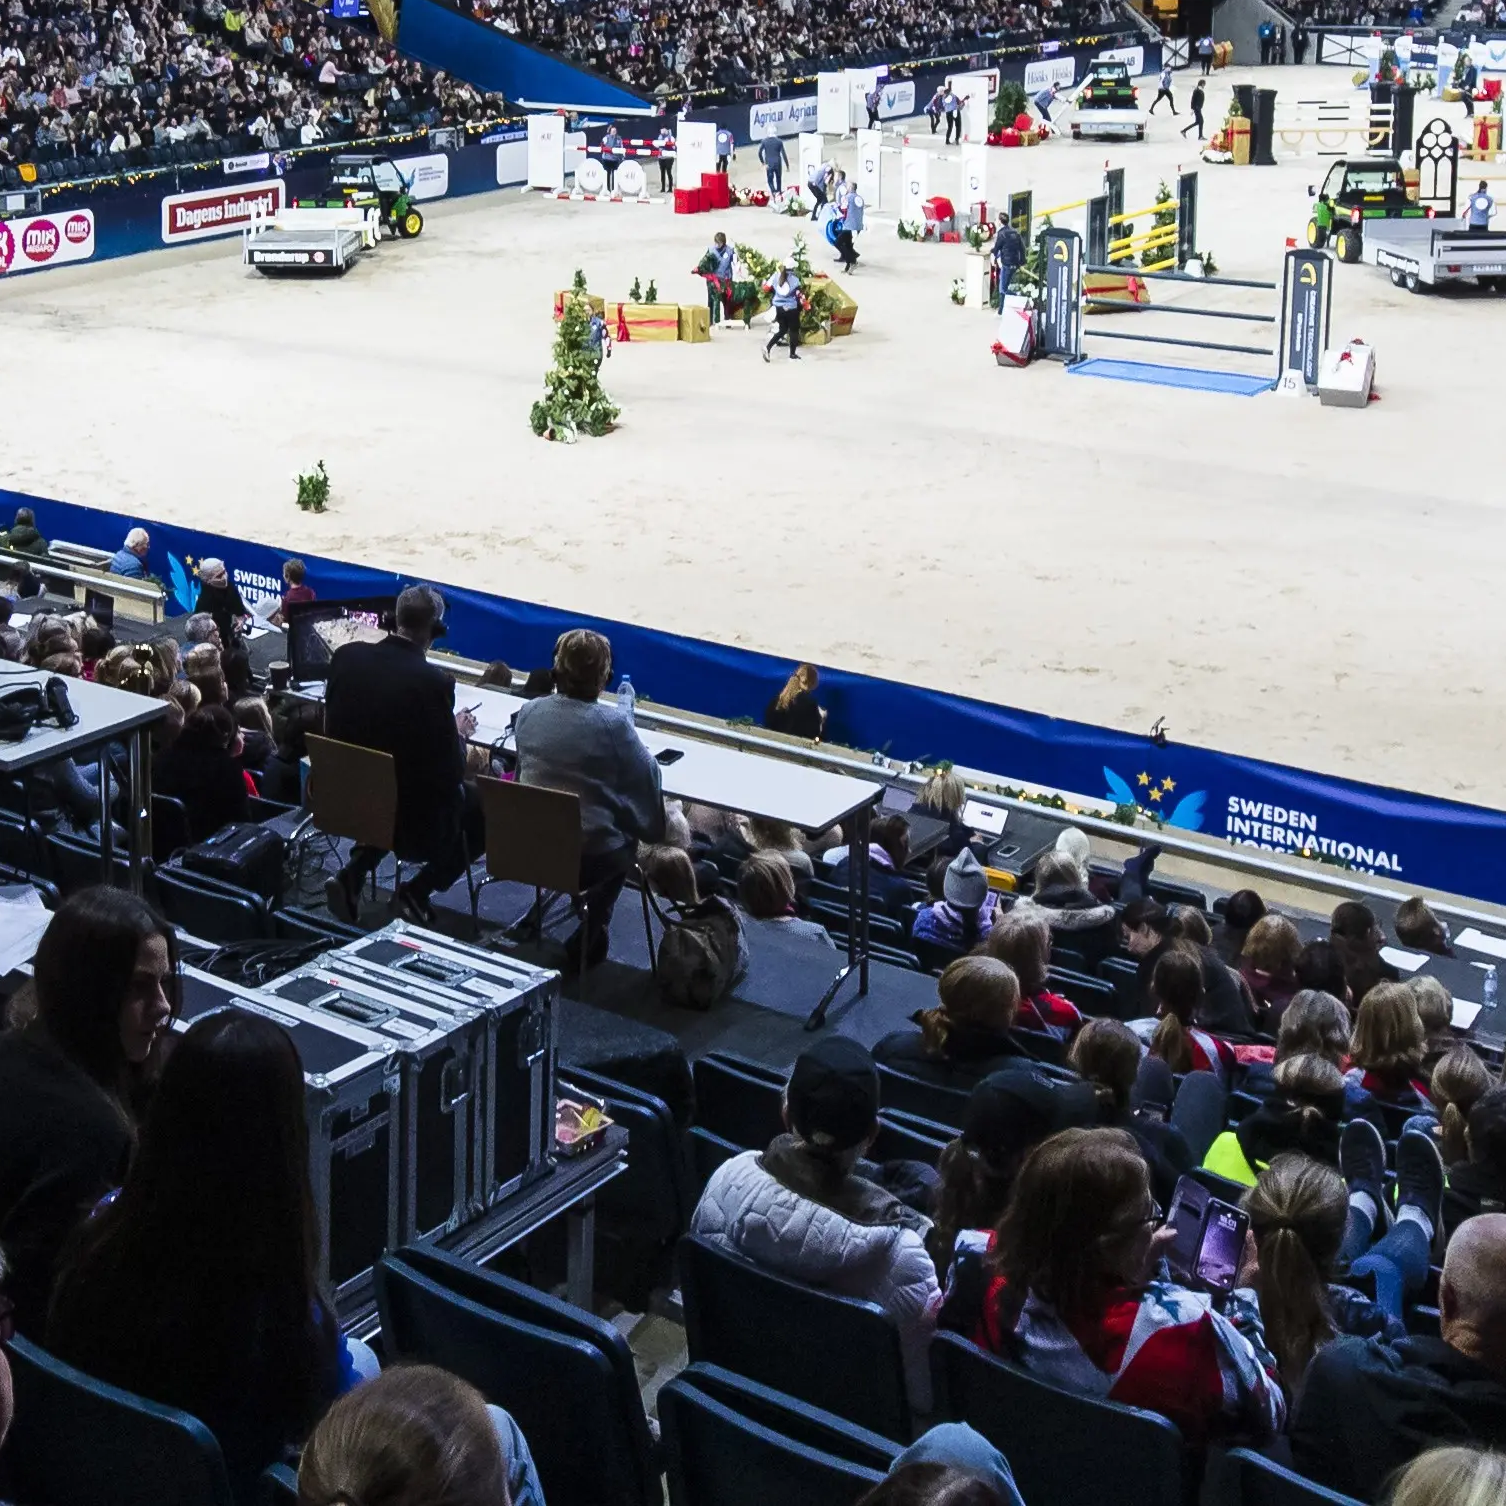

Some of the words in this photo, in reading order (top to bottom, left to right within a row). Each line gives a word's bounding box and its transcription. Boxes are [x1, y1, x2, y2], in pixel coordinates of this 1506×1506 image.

[754, 108, 777, 128] Agria
[789, 102, 812, 122] Agria
[175, 207, 221, 228] Dagens
[224, 192, 273, 220] industri
[1282, 377, 1296, 390] 15
[233, 568, 282, 592] SWEDEN
[1227, 795, 1317, 832] SWEDEN
[1226, 815, 1403, 872] INTERNATIONAL
